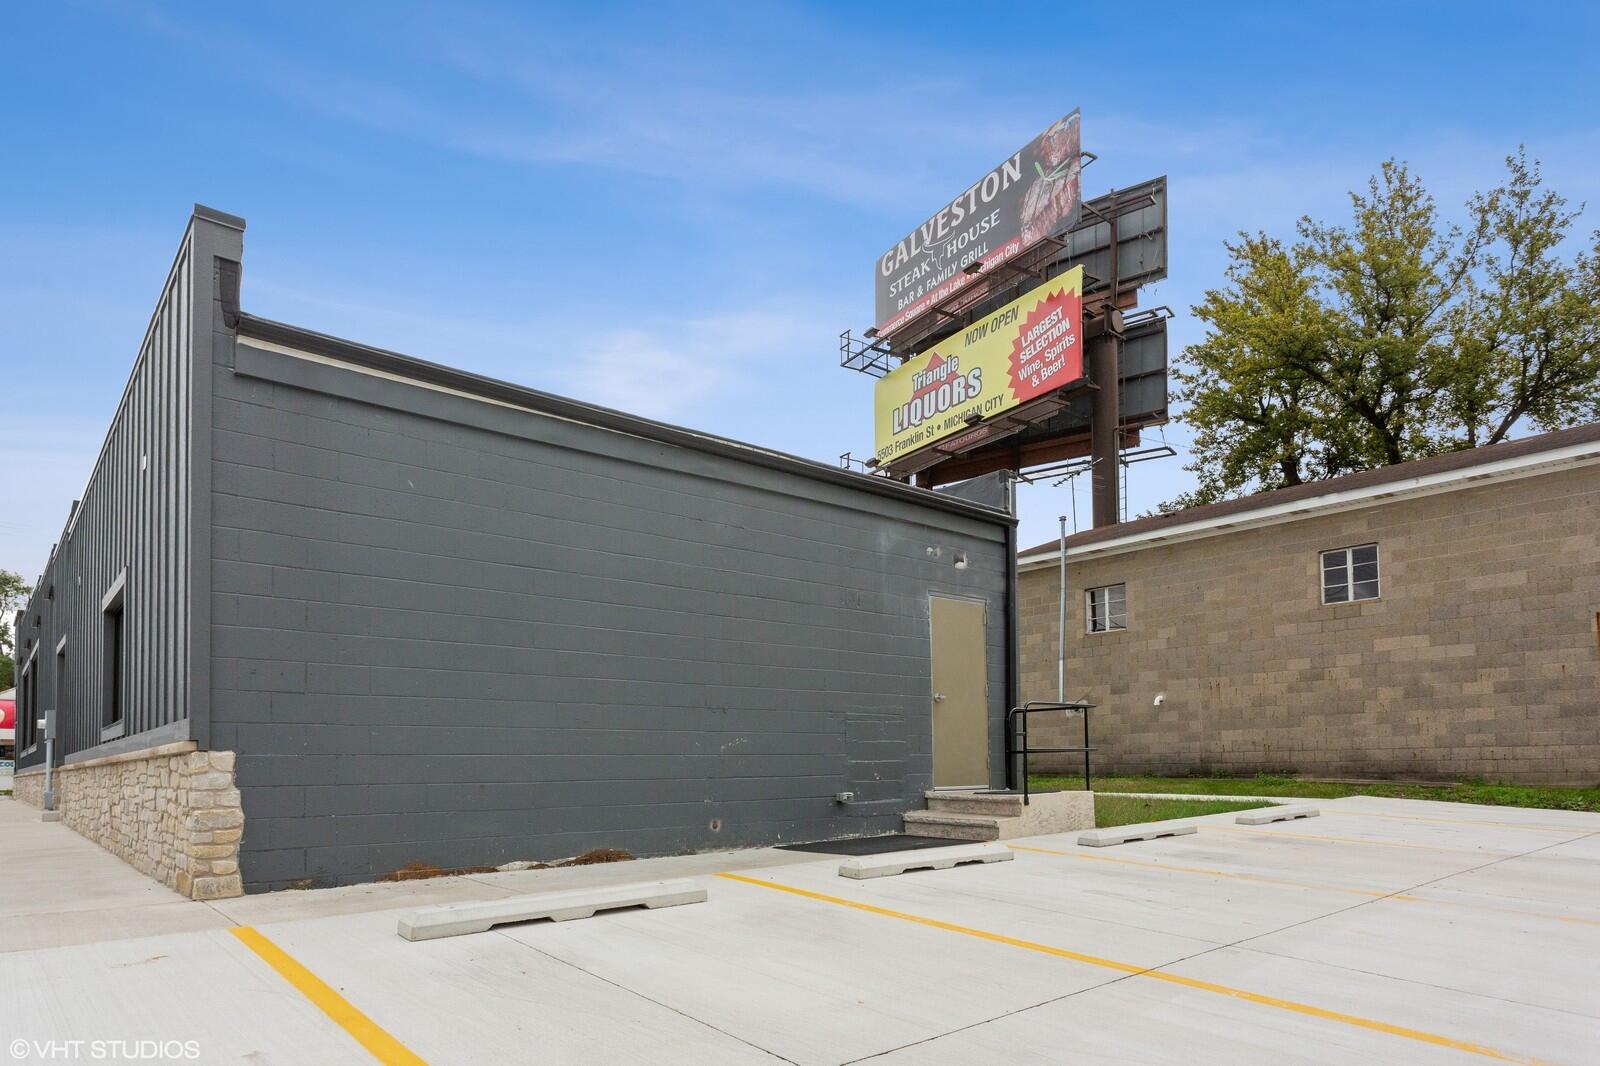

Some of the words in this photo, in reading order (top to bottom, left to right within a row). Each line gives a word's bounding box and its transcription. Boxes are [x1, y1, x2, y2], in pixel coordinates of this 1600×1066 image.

[882, 151, 1022, 277] GALVESTON
[889, 258, 932, 298] STEAK
[946, 208, 1001, 258] HOUSE
[897, 290, 915, 311] BAR
[917, 285, 924, 298] &
[926, 261, 958, 292] FAMILY
[960, 241, 989, 268] GRILL
[949, 275, 966, 293] Lake
[1004, 242, 1020, 258] City
[964, 317, 993, 348] NOW
[990, 306, 1019, 334] OPEN
[1018, 318, 1071, 364] SELECTION
[1021, 306, 1064, 347] LARGEST
[911, 354, 960, 393] Triangle
[1017, 358, 1044, 382] Wine,
[1044, 334, 1076, 364] Spirits
[1031, 374, 1040, 388] &
[1040, 356, 1066, 383] Beer!
[892, 367, 983, 436] LIQUORS
[877, 444, 894, 461] 5503
[894, 430, 924, 453] Franklin
[925, 425, 935, 439] St
[984, 394, 1004, 413] CITY
